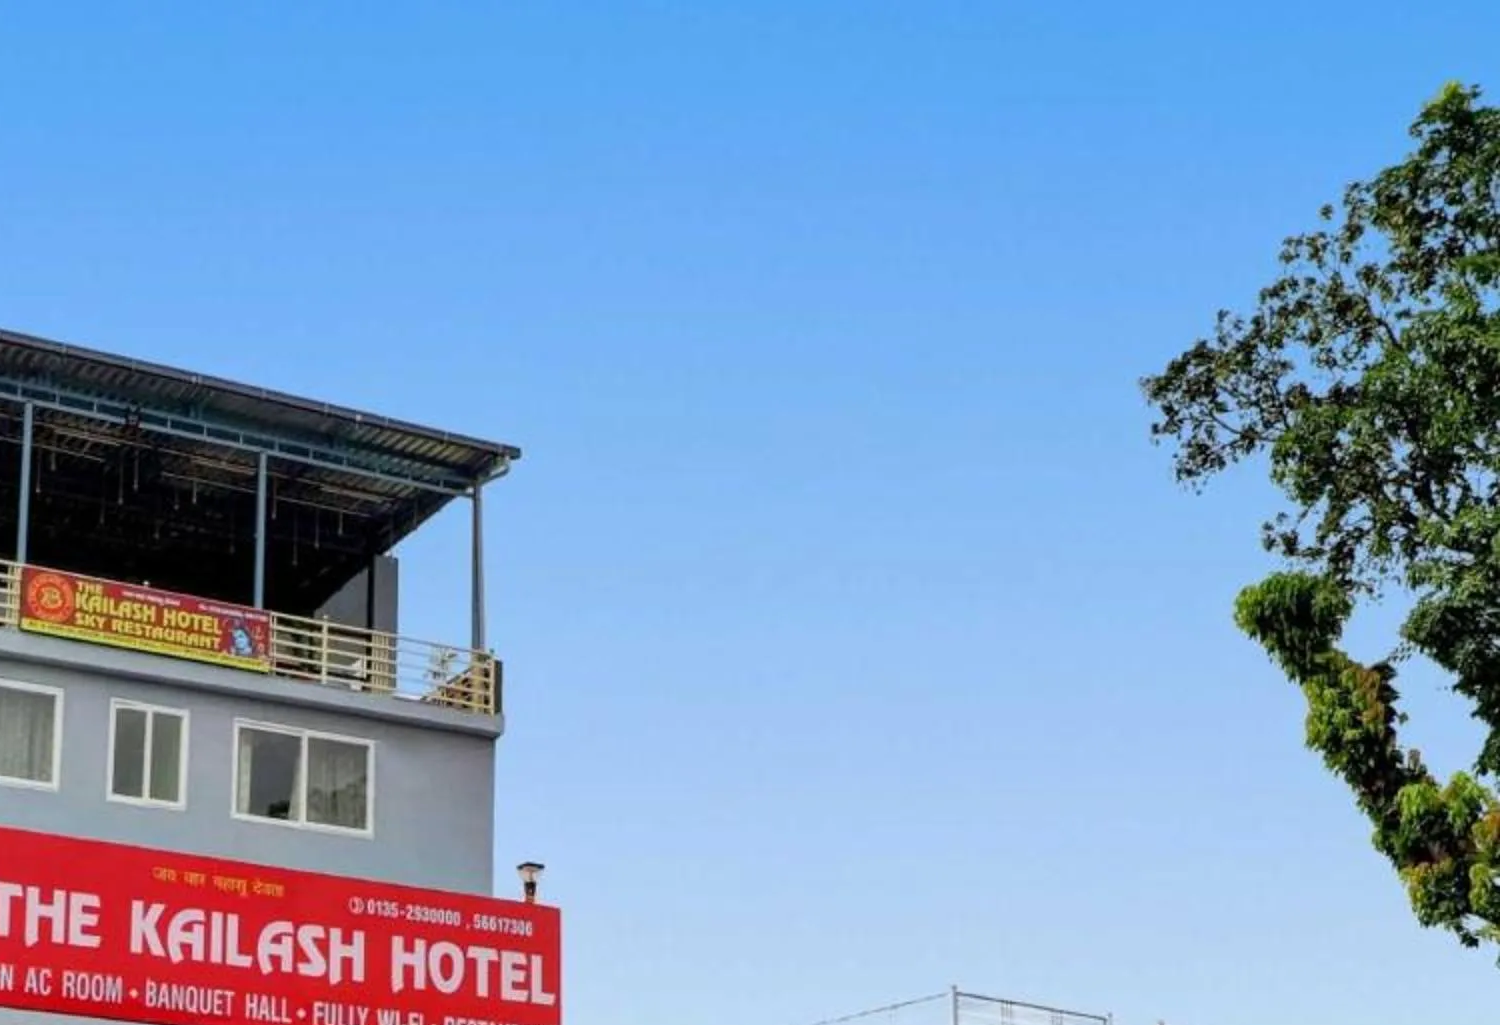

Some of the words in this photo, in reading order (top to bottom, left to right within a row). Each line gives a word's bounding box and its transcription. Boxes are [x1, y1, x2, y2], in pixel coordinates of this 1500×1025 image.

[77, 581, 103, 596] THE
[75, 591, 156, 621] KAILASH
[163, 609, 222, 634] HOTEL
[76, 612, 105, 632] SKY
[112, 618, 221, 650] RESTAURANT
[130, 899, 365, 985] KAILASH
[392, 935, 556, 1006] HOTEL
[24, 968, 52, 996] AC
[62, 970, 123, 1004] ROOM
[145, 979, 235, 1017] BANQUET
[245, 993, 292, 1024] HALL
